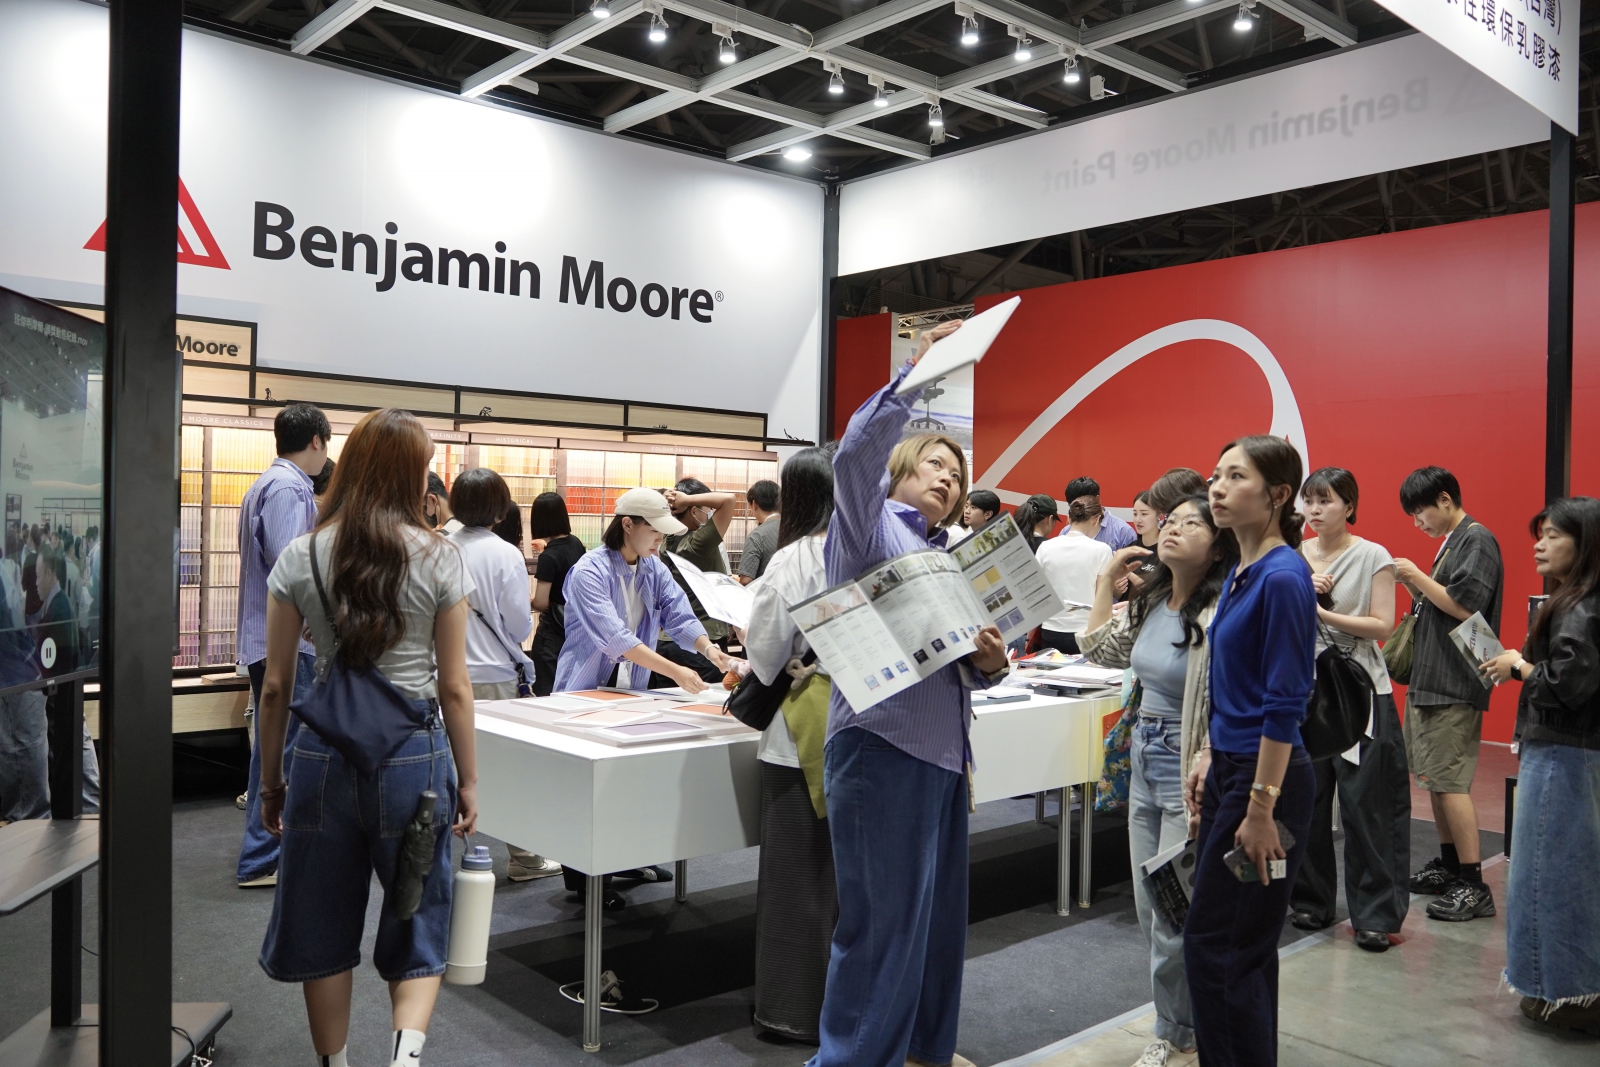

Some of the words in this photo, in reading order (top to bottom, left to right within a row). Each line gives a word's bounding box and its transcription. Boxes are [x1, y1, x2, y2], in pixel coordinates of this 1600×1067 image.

[253, 201, 541, 300] Benjamin
[188, 416, 220, 424] MOORE
[223, 418, 264, 426] CLASSICS
